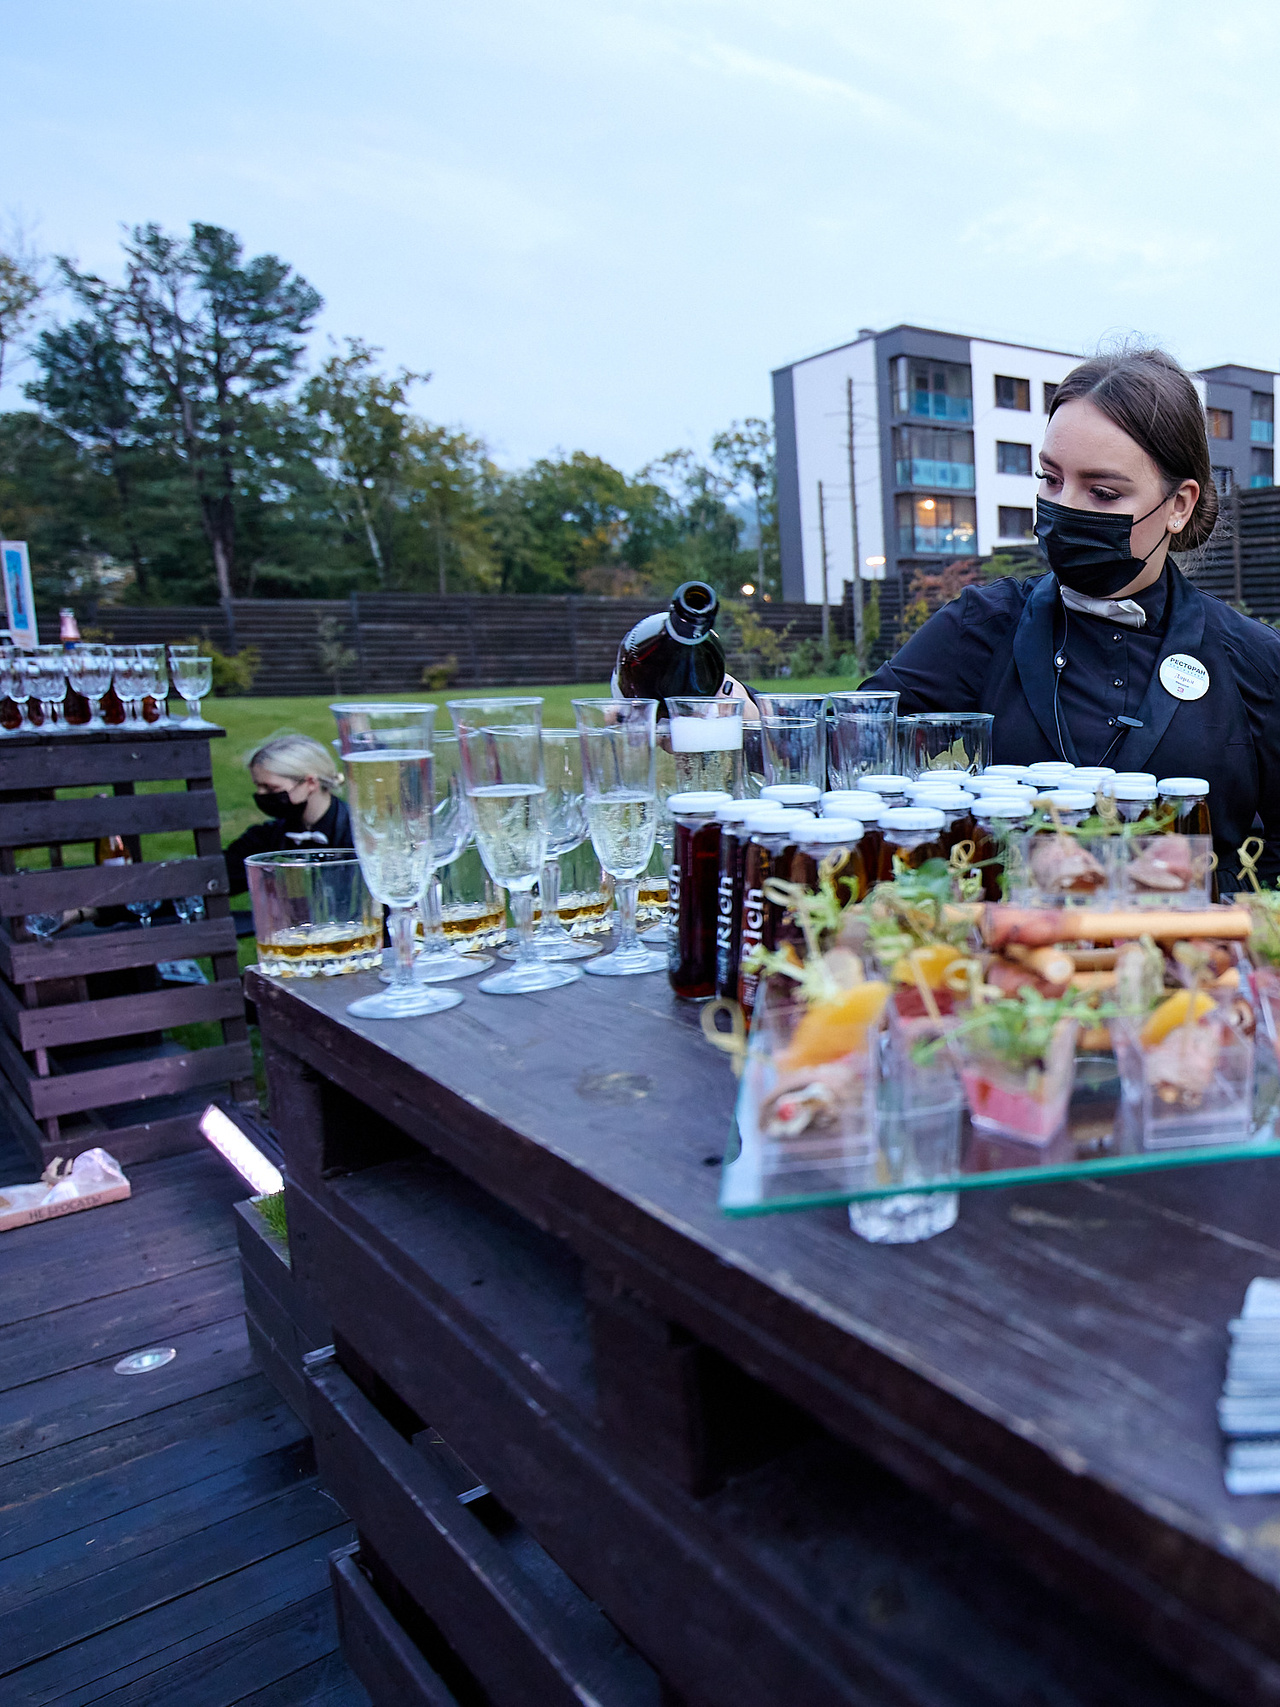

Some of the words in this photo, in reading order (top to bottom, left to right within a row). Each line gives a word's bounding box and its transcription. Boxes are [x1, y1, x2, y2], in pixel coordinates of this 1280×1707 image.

[1170, 657, 1205, 675] РЕСТОРАН
[667, 864, 682, 932] Rich
[717, 876, 734, 949] Rich
[742, 888, 764, 963] Rich
